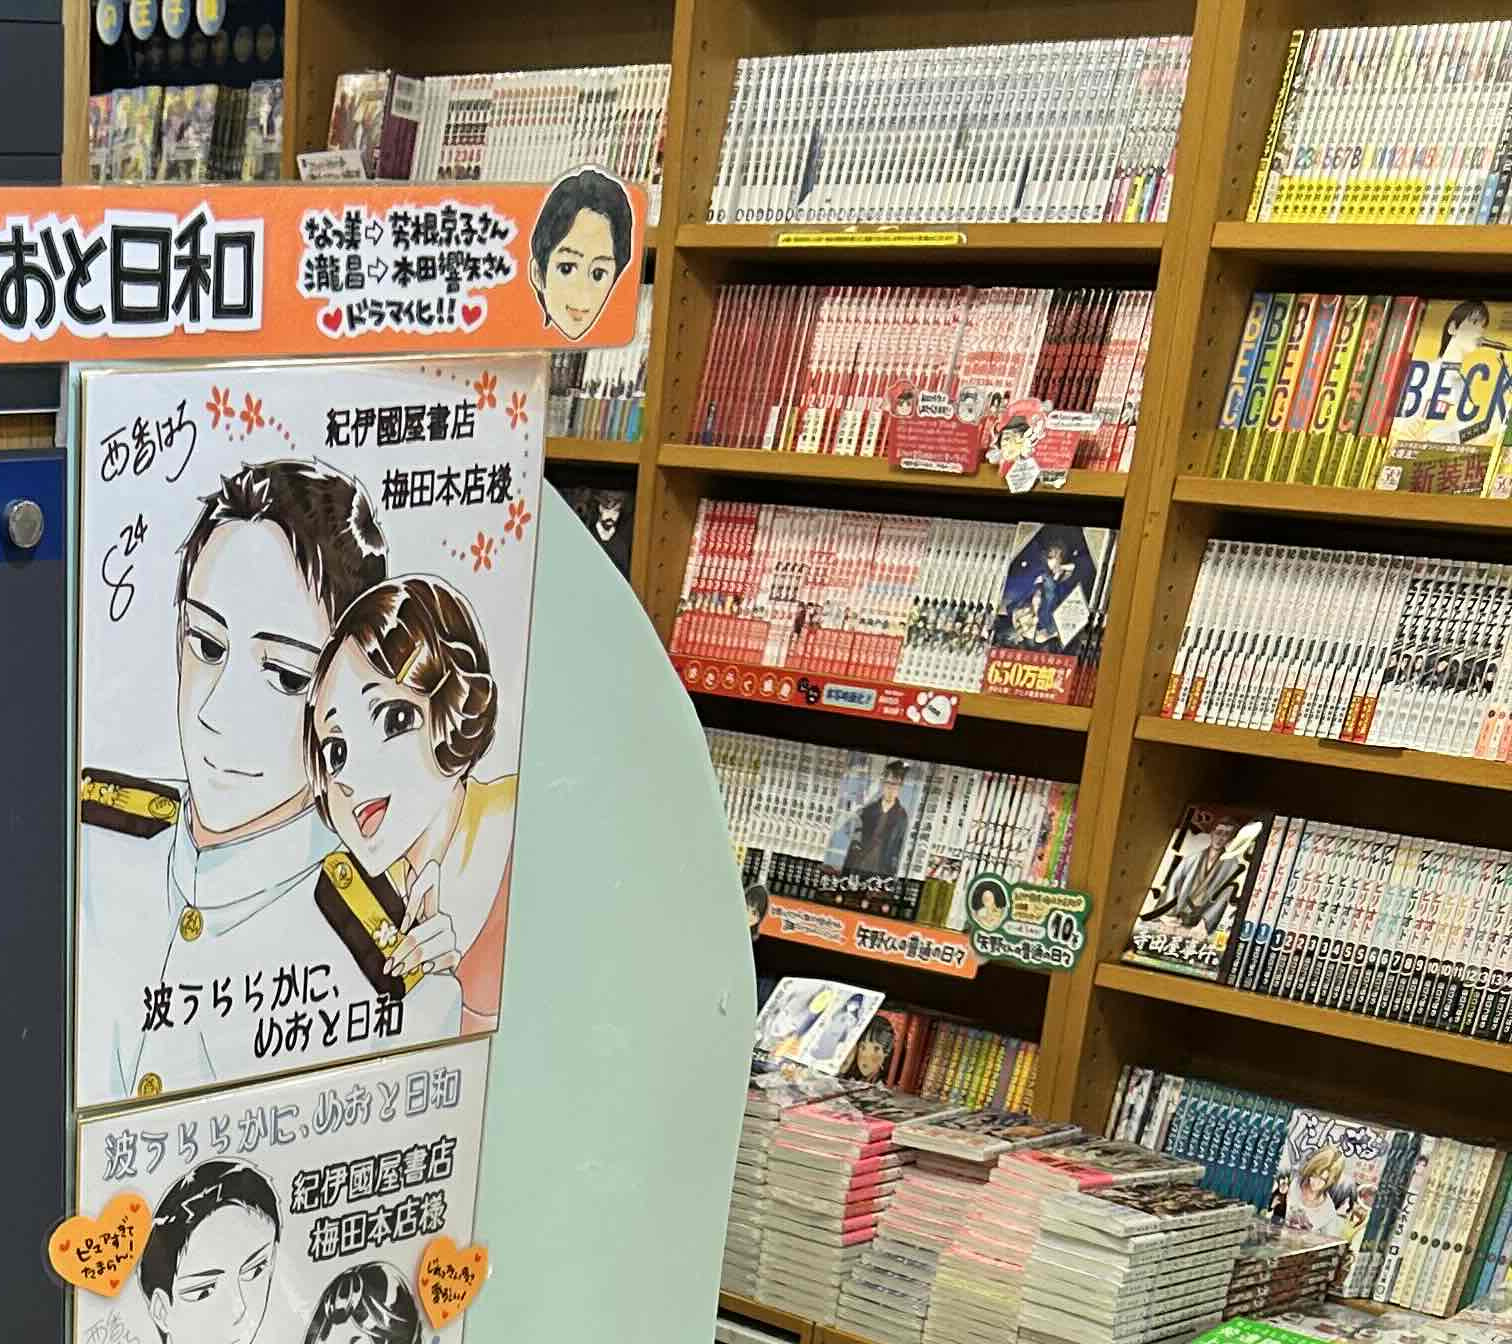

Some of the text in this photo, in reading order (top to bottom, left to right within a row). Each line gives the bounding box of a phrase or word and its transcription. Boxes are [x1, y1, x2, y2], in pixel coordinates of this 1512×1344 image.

[325, 400, 477, 449] 紀伊國屋書店
[381, 462, 515, 509] 梅田本店様
[140, 963, 341, 1034] 波うららかに、
[254, 998, 405, 1060] めおと日和
[290, 1136, 458, 1214] 紀伊國屋書店
[307, 1191, 448, 1265] 梅田本店様
